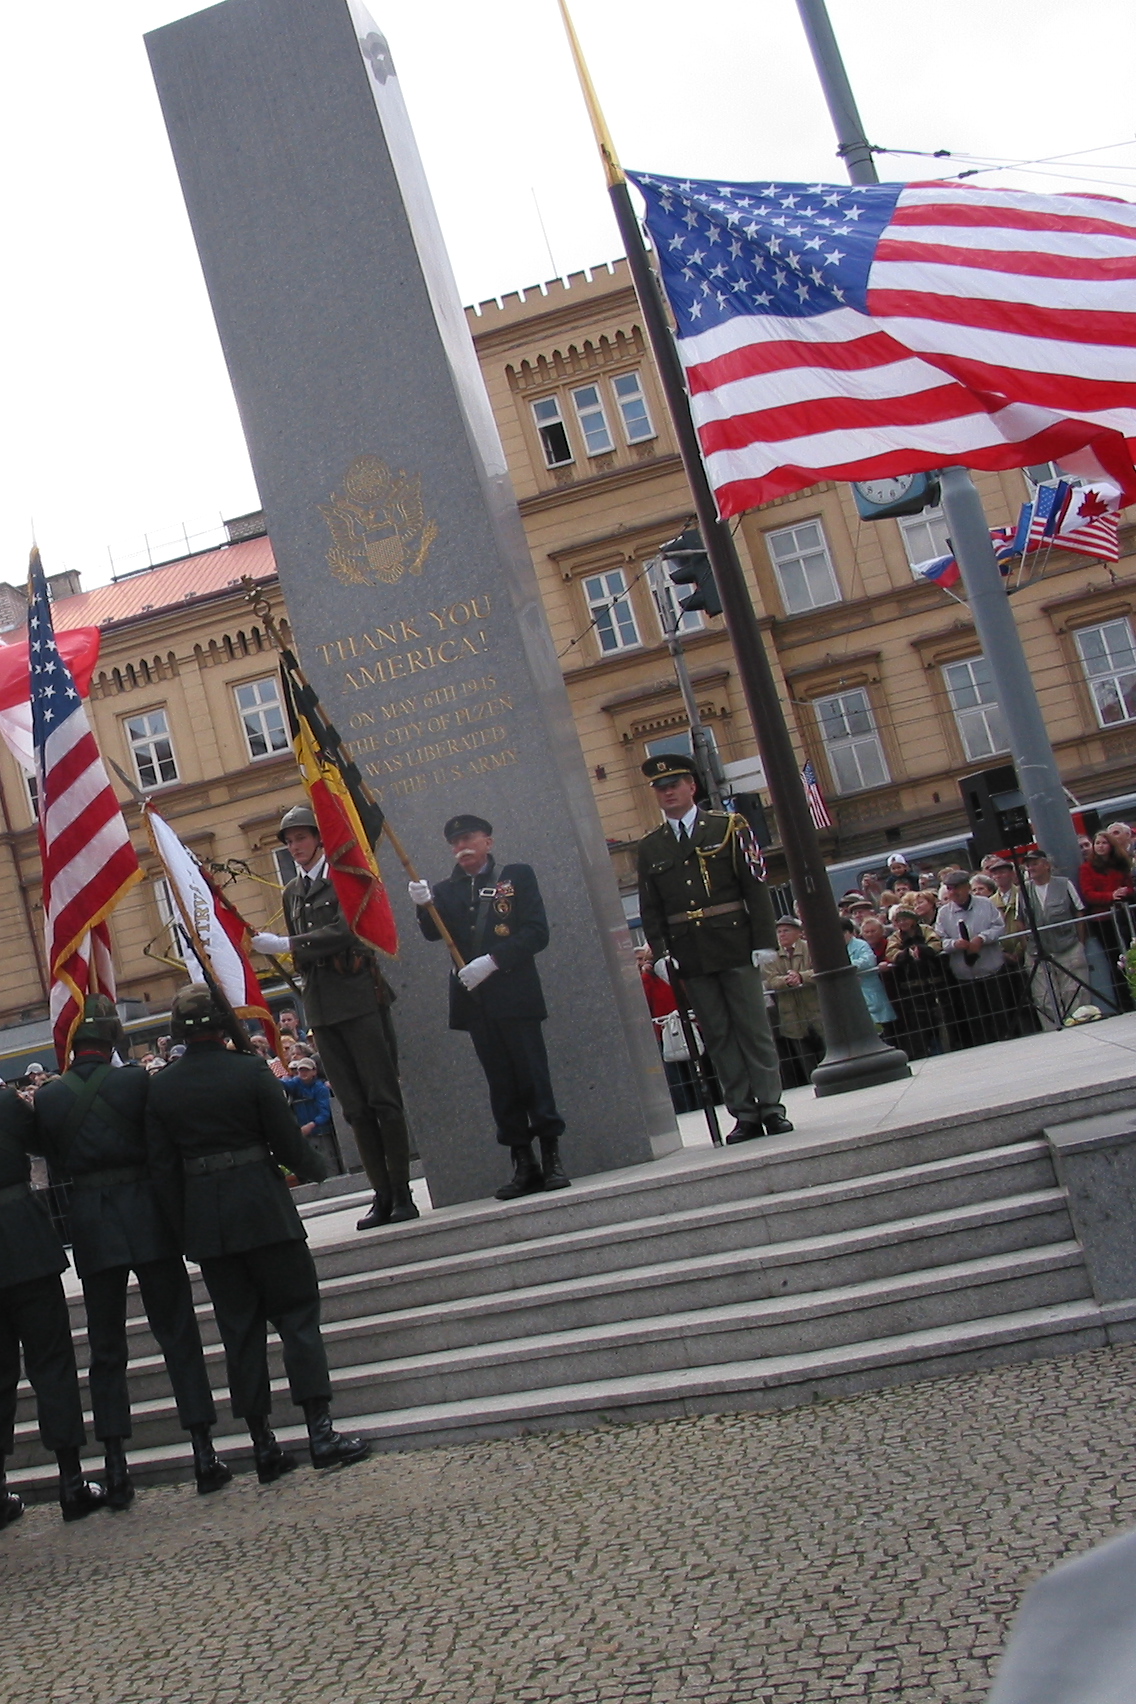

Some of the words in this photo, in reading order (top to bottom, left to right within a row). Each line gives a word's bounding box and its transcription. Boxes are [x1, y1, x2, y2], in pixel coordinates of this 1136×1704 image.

[316, 617, 422, 665] THANK
[428, 595, 492, 631] YOU
[342, 631, 489, 694] AMERICA!
[349, 710, 377, 729] ON
[381, 696, 418, 720] MAY
[461, 674, 496, 696] 1945
[344, 735, 380, 757] THE
[384, 721, 424, 746] CITY
[427, 713, 450, 733] OF
[365, 755, 404, 777] WAS
[405, 725, 507, 767] LIBERATED
[391, 774, 428, 797] THE
[469, 748, 520, 774] ARMY
